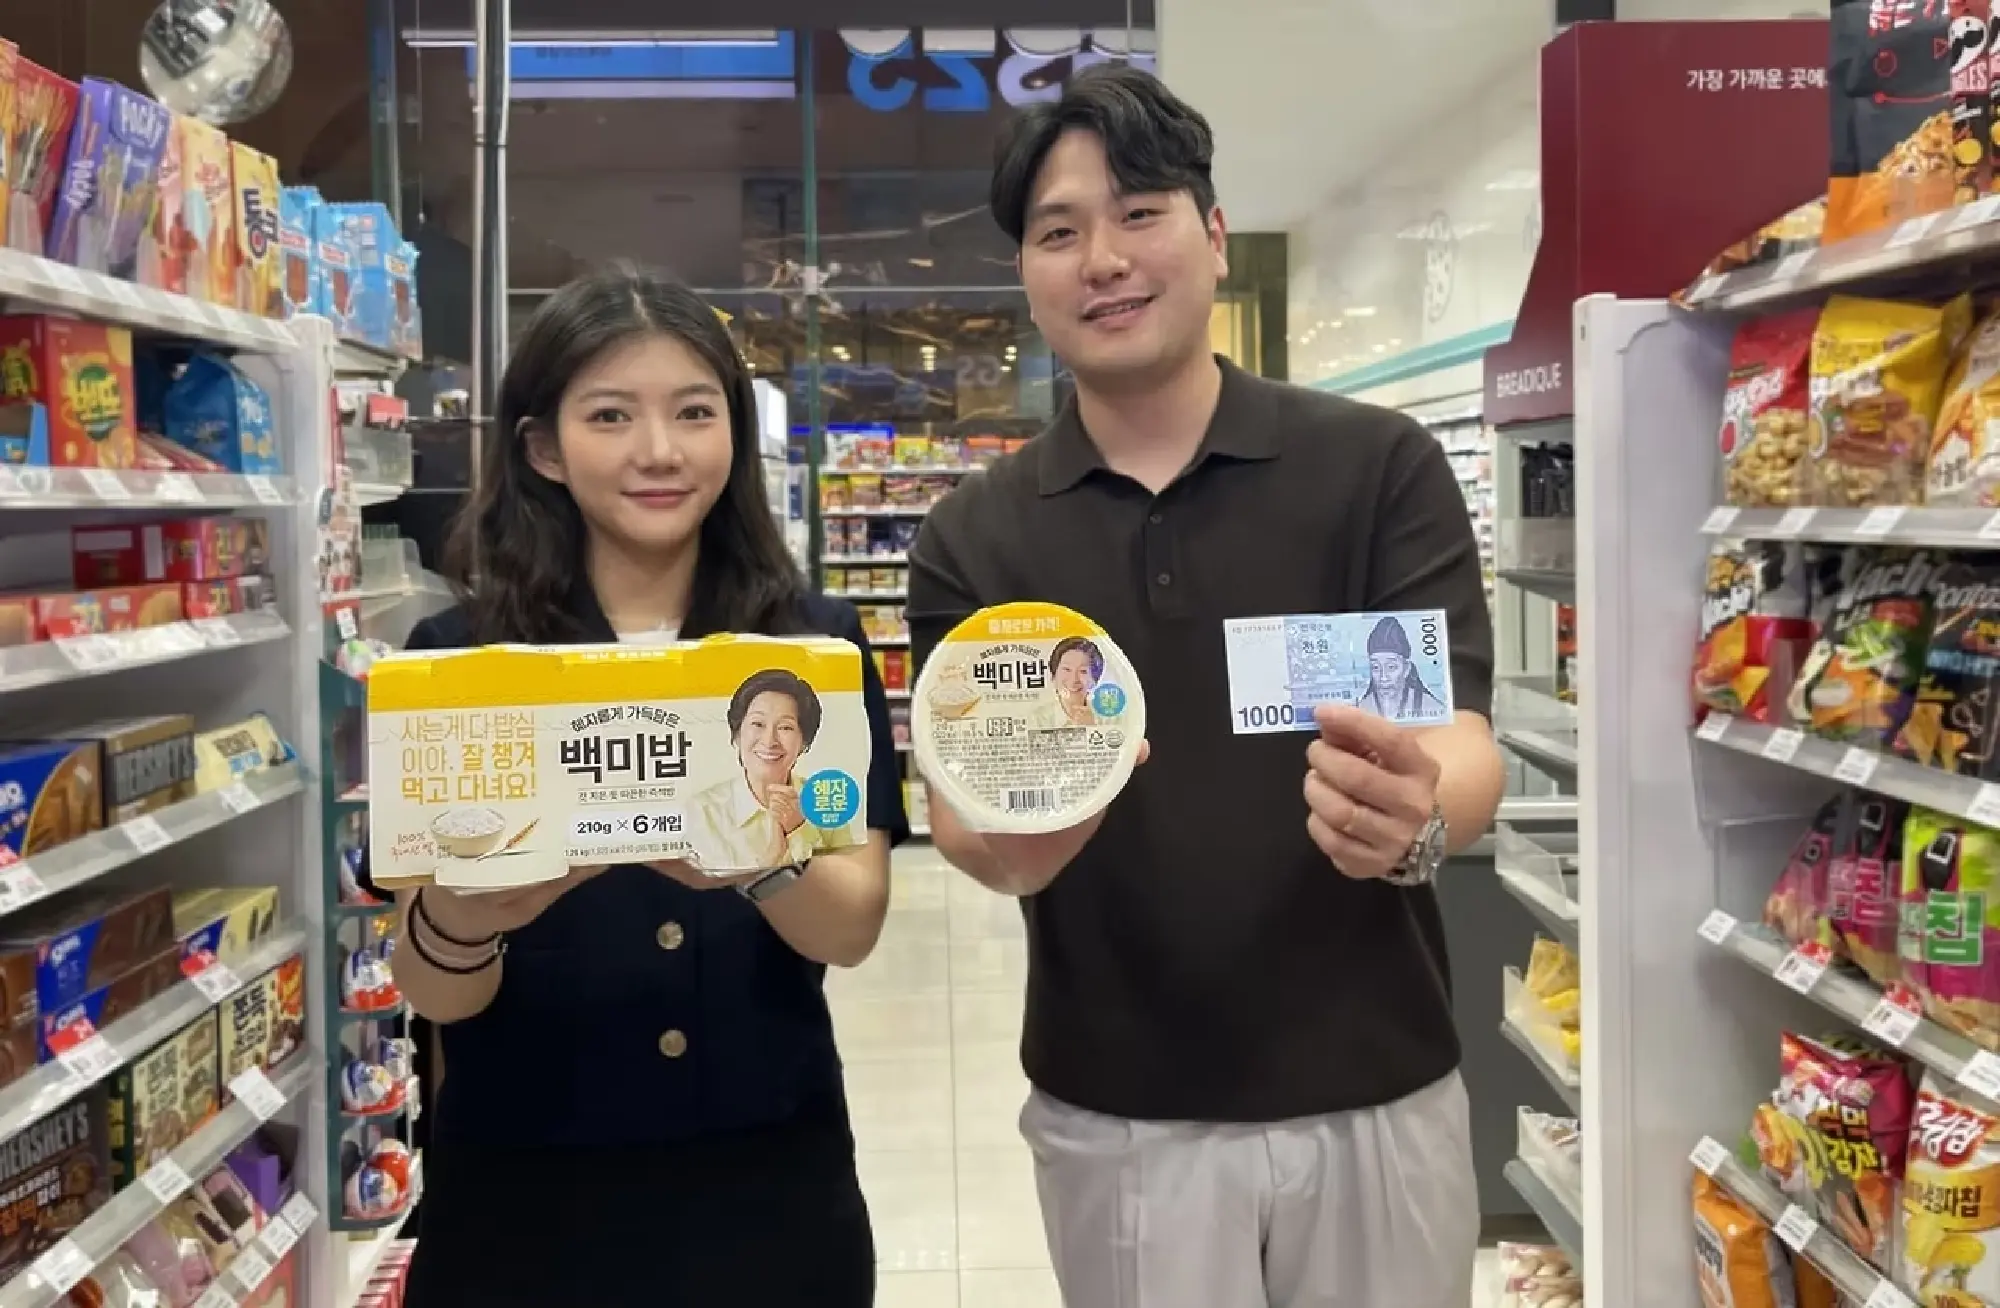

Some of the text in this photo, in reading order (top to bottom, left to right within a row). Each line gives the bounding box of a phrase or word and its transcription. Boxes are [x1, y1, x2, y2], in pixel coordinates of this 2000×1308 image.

[1687, 68, 1829, 90] 가장 가까운 곳에
[1496, 363, 1562, 398] BREADIQUE
[1420, 616, 1438, 656] 1000
[973, 659, 1047, 690] 백미밥
[400, 714, 464, 742] 사는게
[494, 712, 534, 738] 밥심
[570, 706, 681, 732] 혜자롭게 가득담은
[1237, 704, 1294, 728] 1000
[116, 733, 197, 805] HERSHEY'S
[403, 741, 535, 773] 이야. 잘 챙겨
[560, 731, 692, 783] 백미밥
[402, 772, 536, 805] 먹고 다녀요!
[812, 778, 848, 795] 혜자
[813, 795, 848, 812] 로운
[577, 821, 612, 835] 210g
